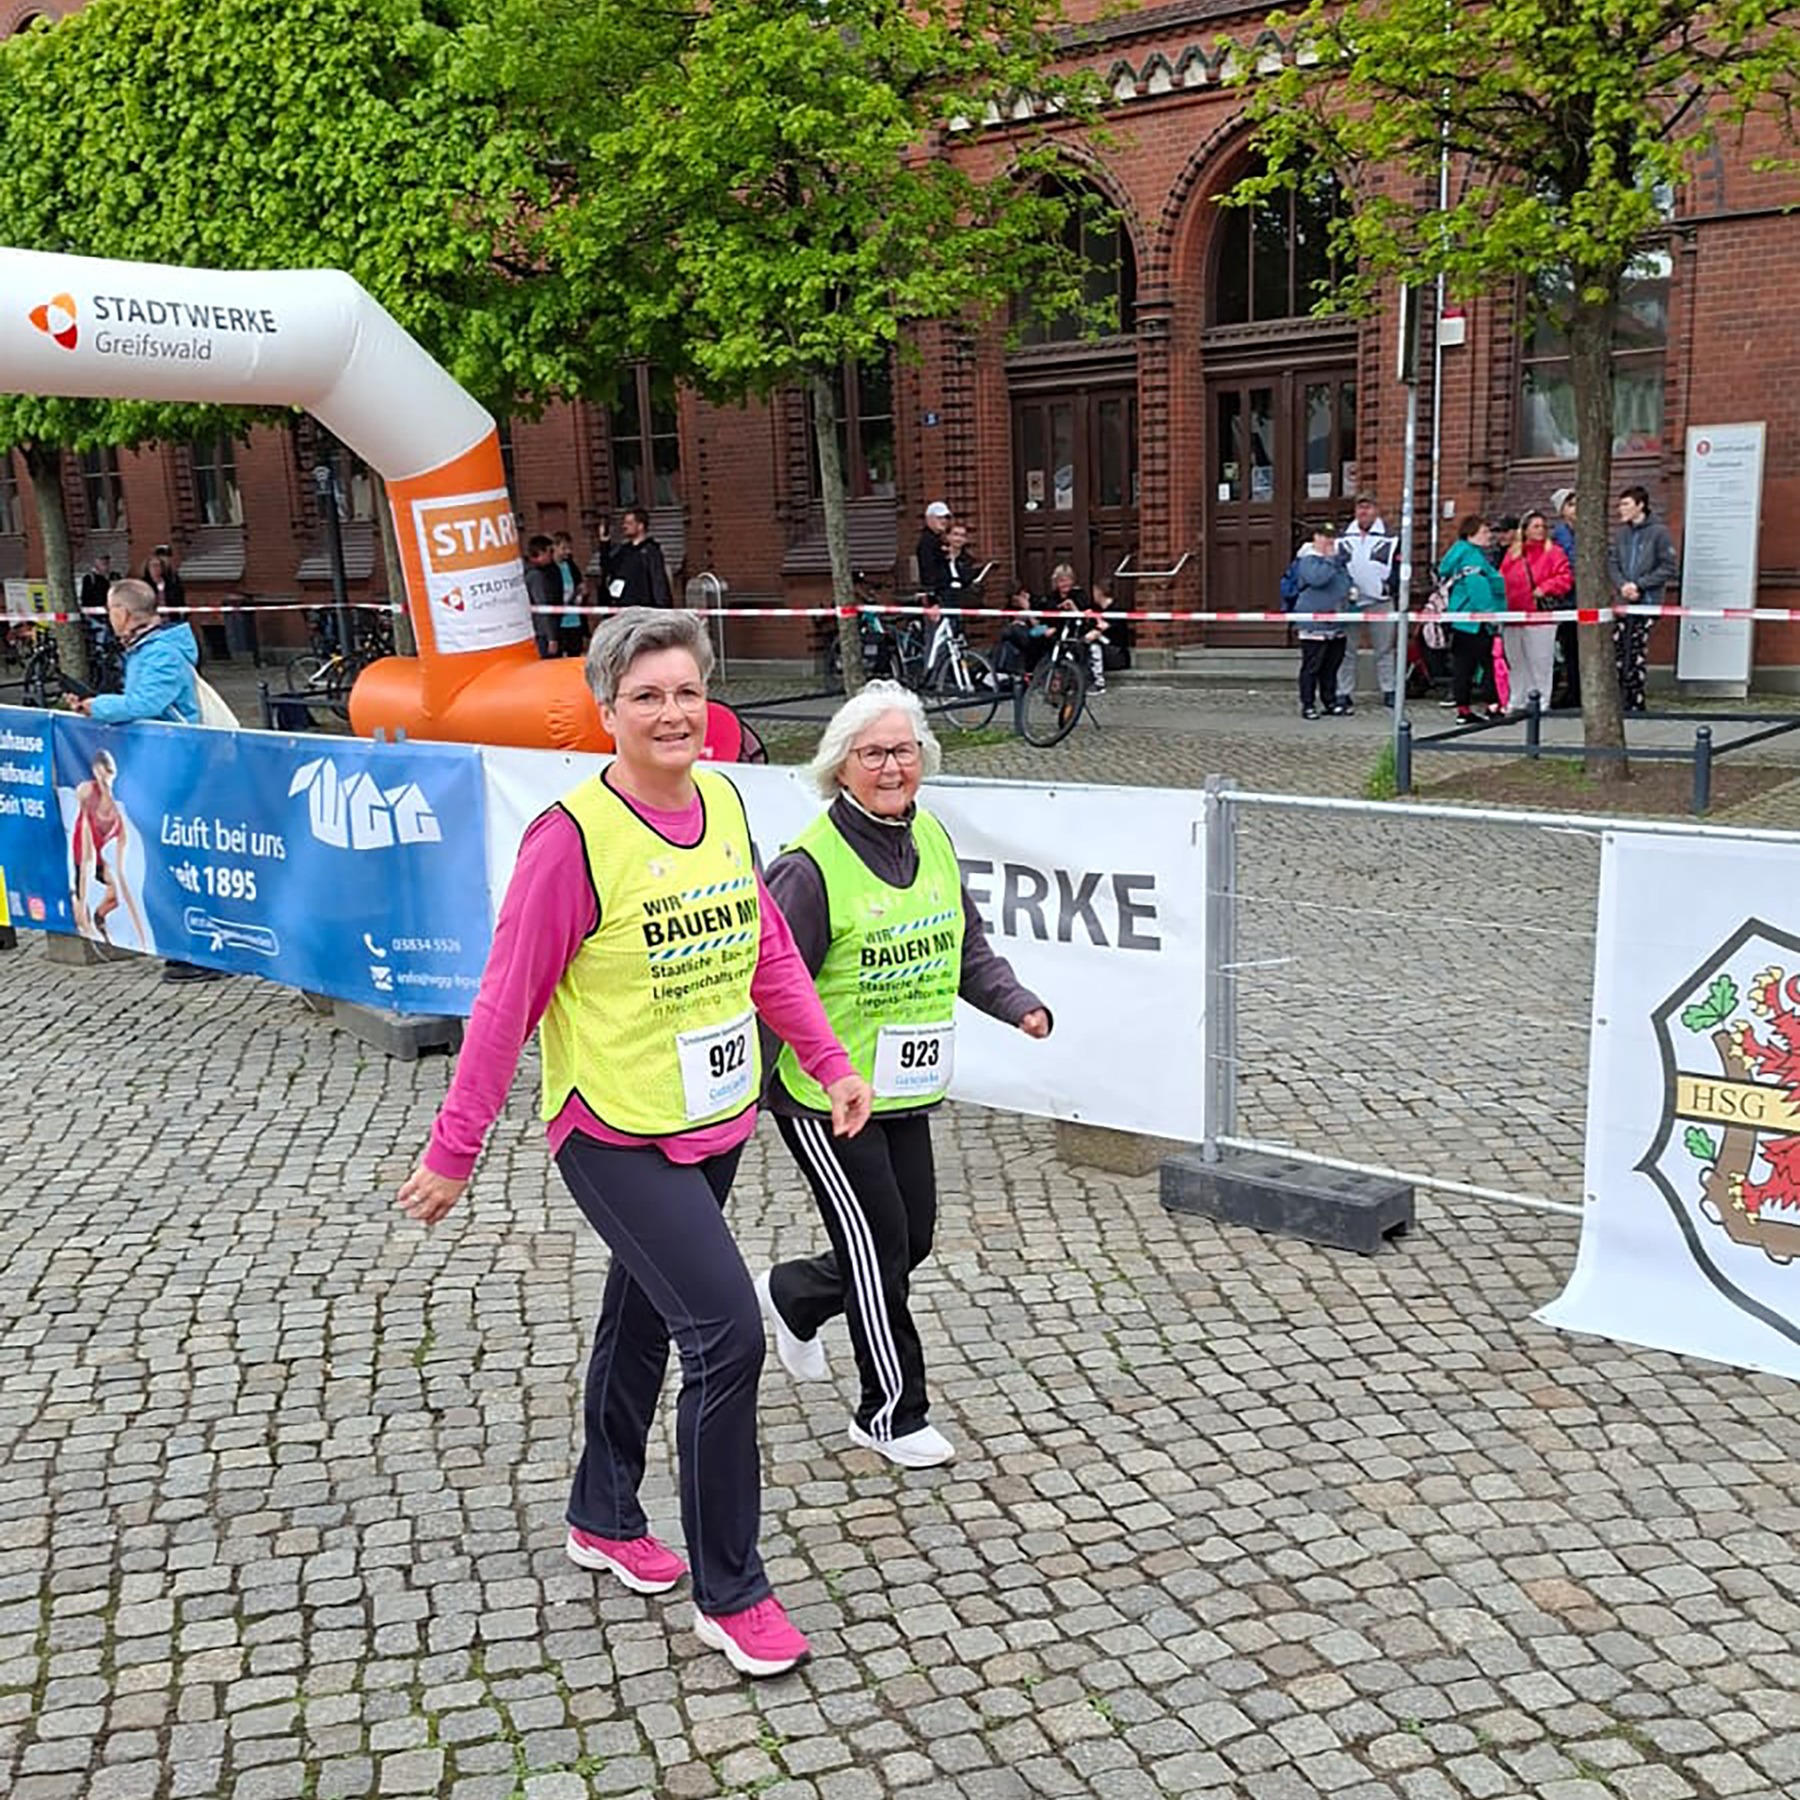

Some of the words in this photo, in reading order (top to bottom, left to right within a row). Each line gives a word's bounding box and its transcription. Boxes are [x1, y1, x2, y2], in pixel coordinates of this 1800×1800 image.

[93, 295, 277, 333] STADTWERKE
[95, 331, 212, 360] Greifswald
[161, 813, 210, 850] Läuft
[215, 818, 246, 853] bei
[252, 832, 286, 860] uns
[203, 866, 257, 900] 1895
[642, 895, 682, 917] WIR
[957, 857, 1160, 952] ERKE
[642, 904, 733, 947] BAUEN
[861, 937, 930, 967] BAUEN
[709, 1034, 746, 1078] 922
[900, 1038, 939, 1068] 923
[1692, 1083, 1766, 1120] HSG
